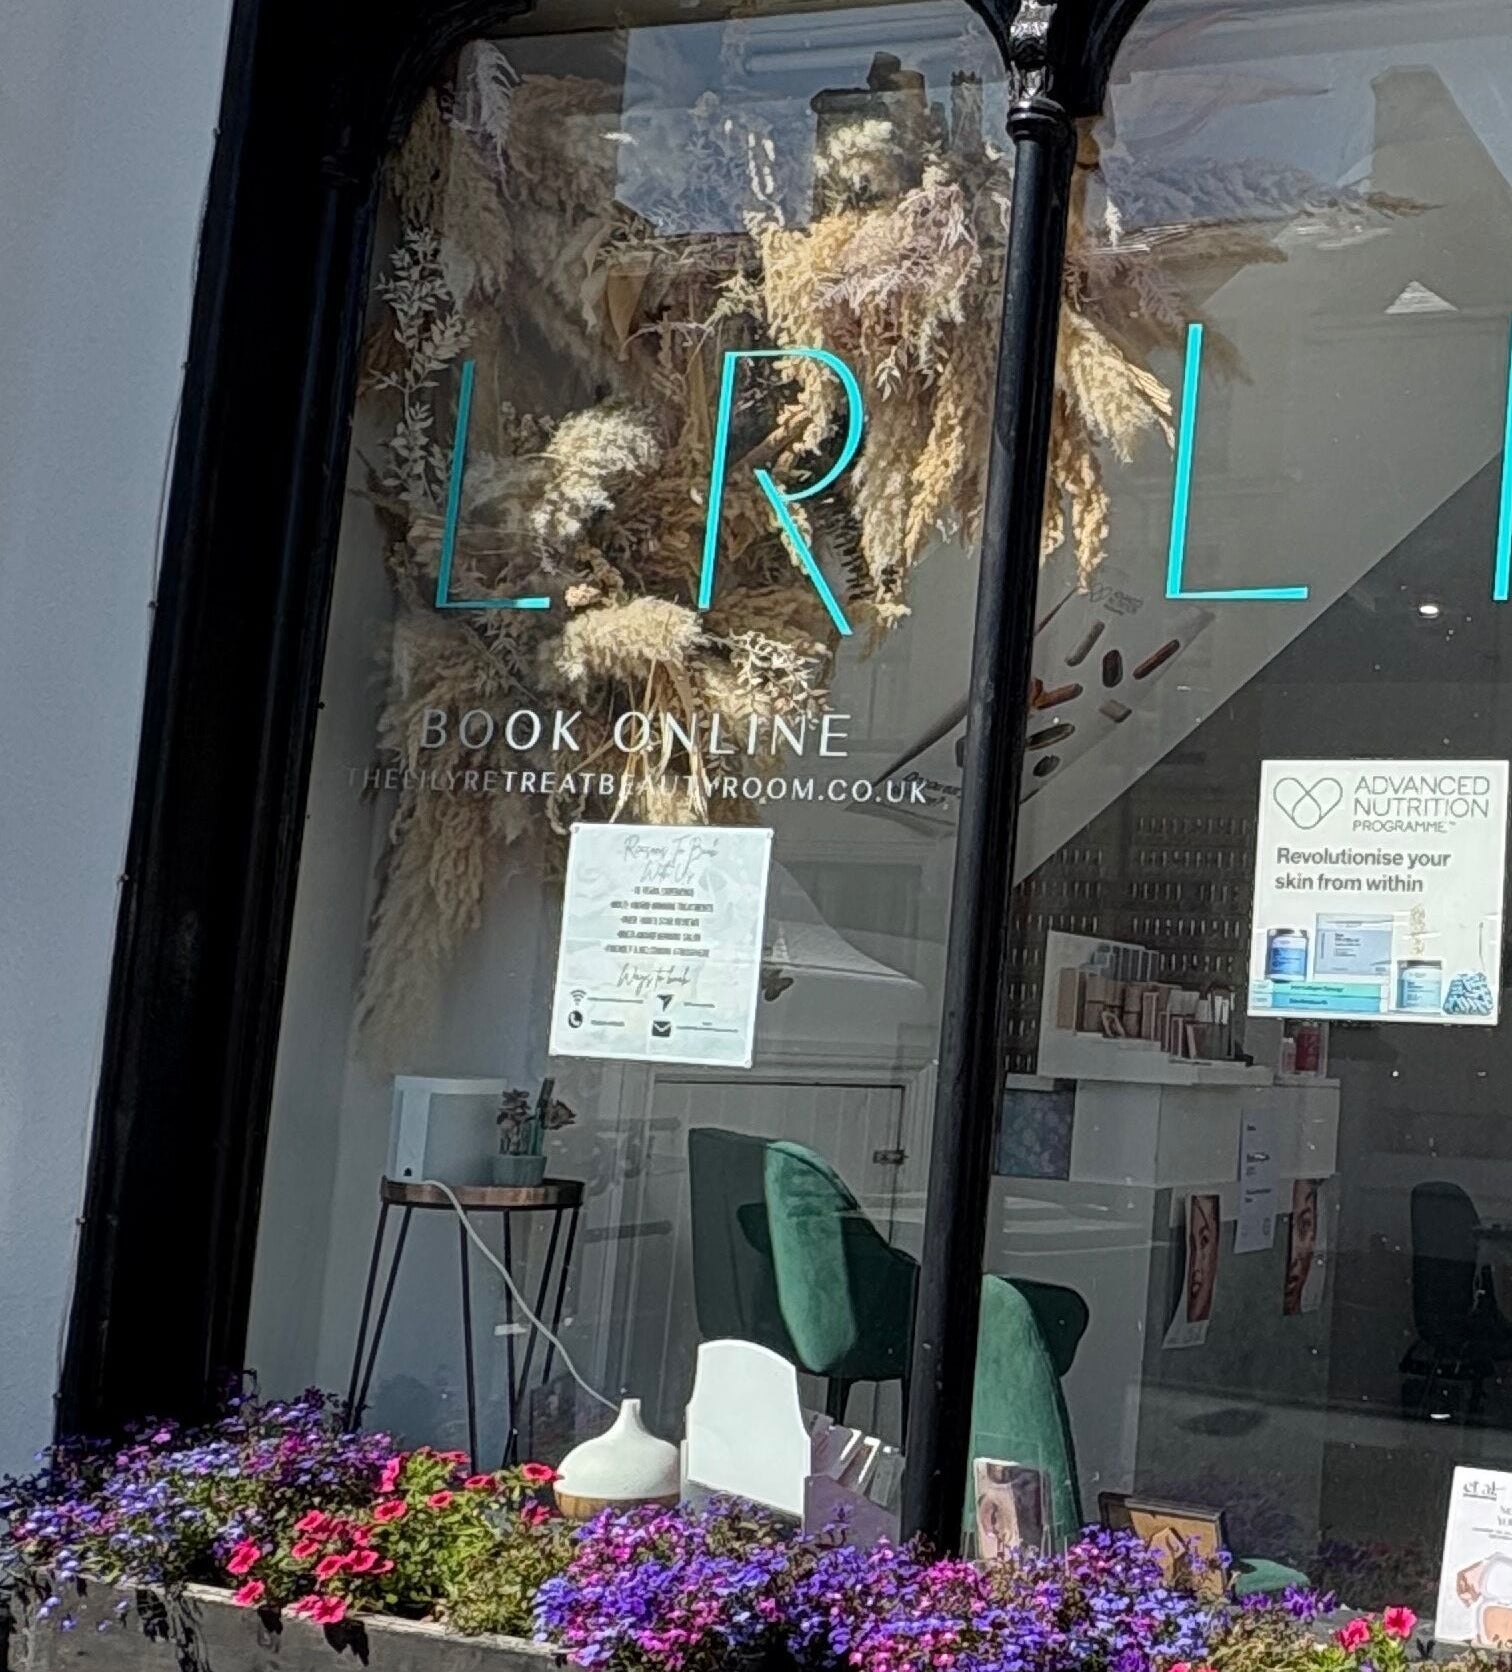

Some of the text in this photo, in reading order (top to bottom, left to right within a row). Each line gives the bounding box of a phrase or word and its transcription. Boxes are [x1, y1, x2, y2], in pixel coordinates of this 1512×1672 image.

[1165, 323, 1309, 599] L
[435, 348, 865, 636] L R
[420, 708, 852, 758] BOOK ONLINE
[1354, 776, 1490, 796] ADVANCED
[1353, 797, 1490, 818] NUTRITION
[1276, 847, 1452, 870] Revolutionise your
[1275, 872, 1424, 893] skin from within
